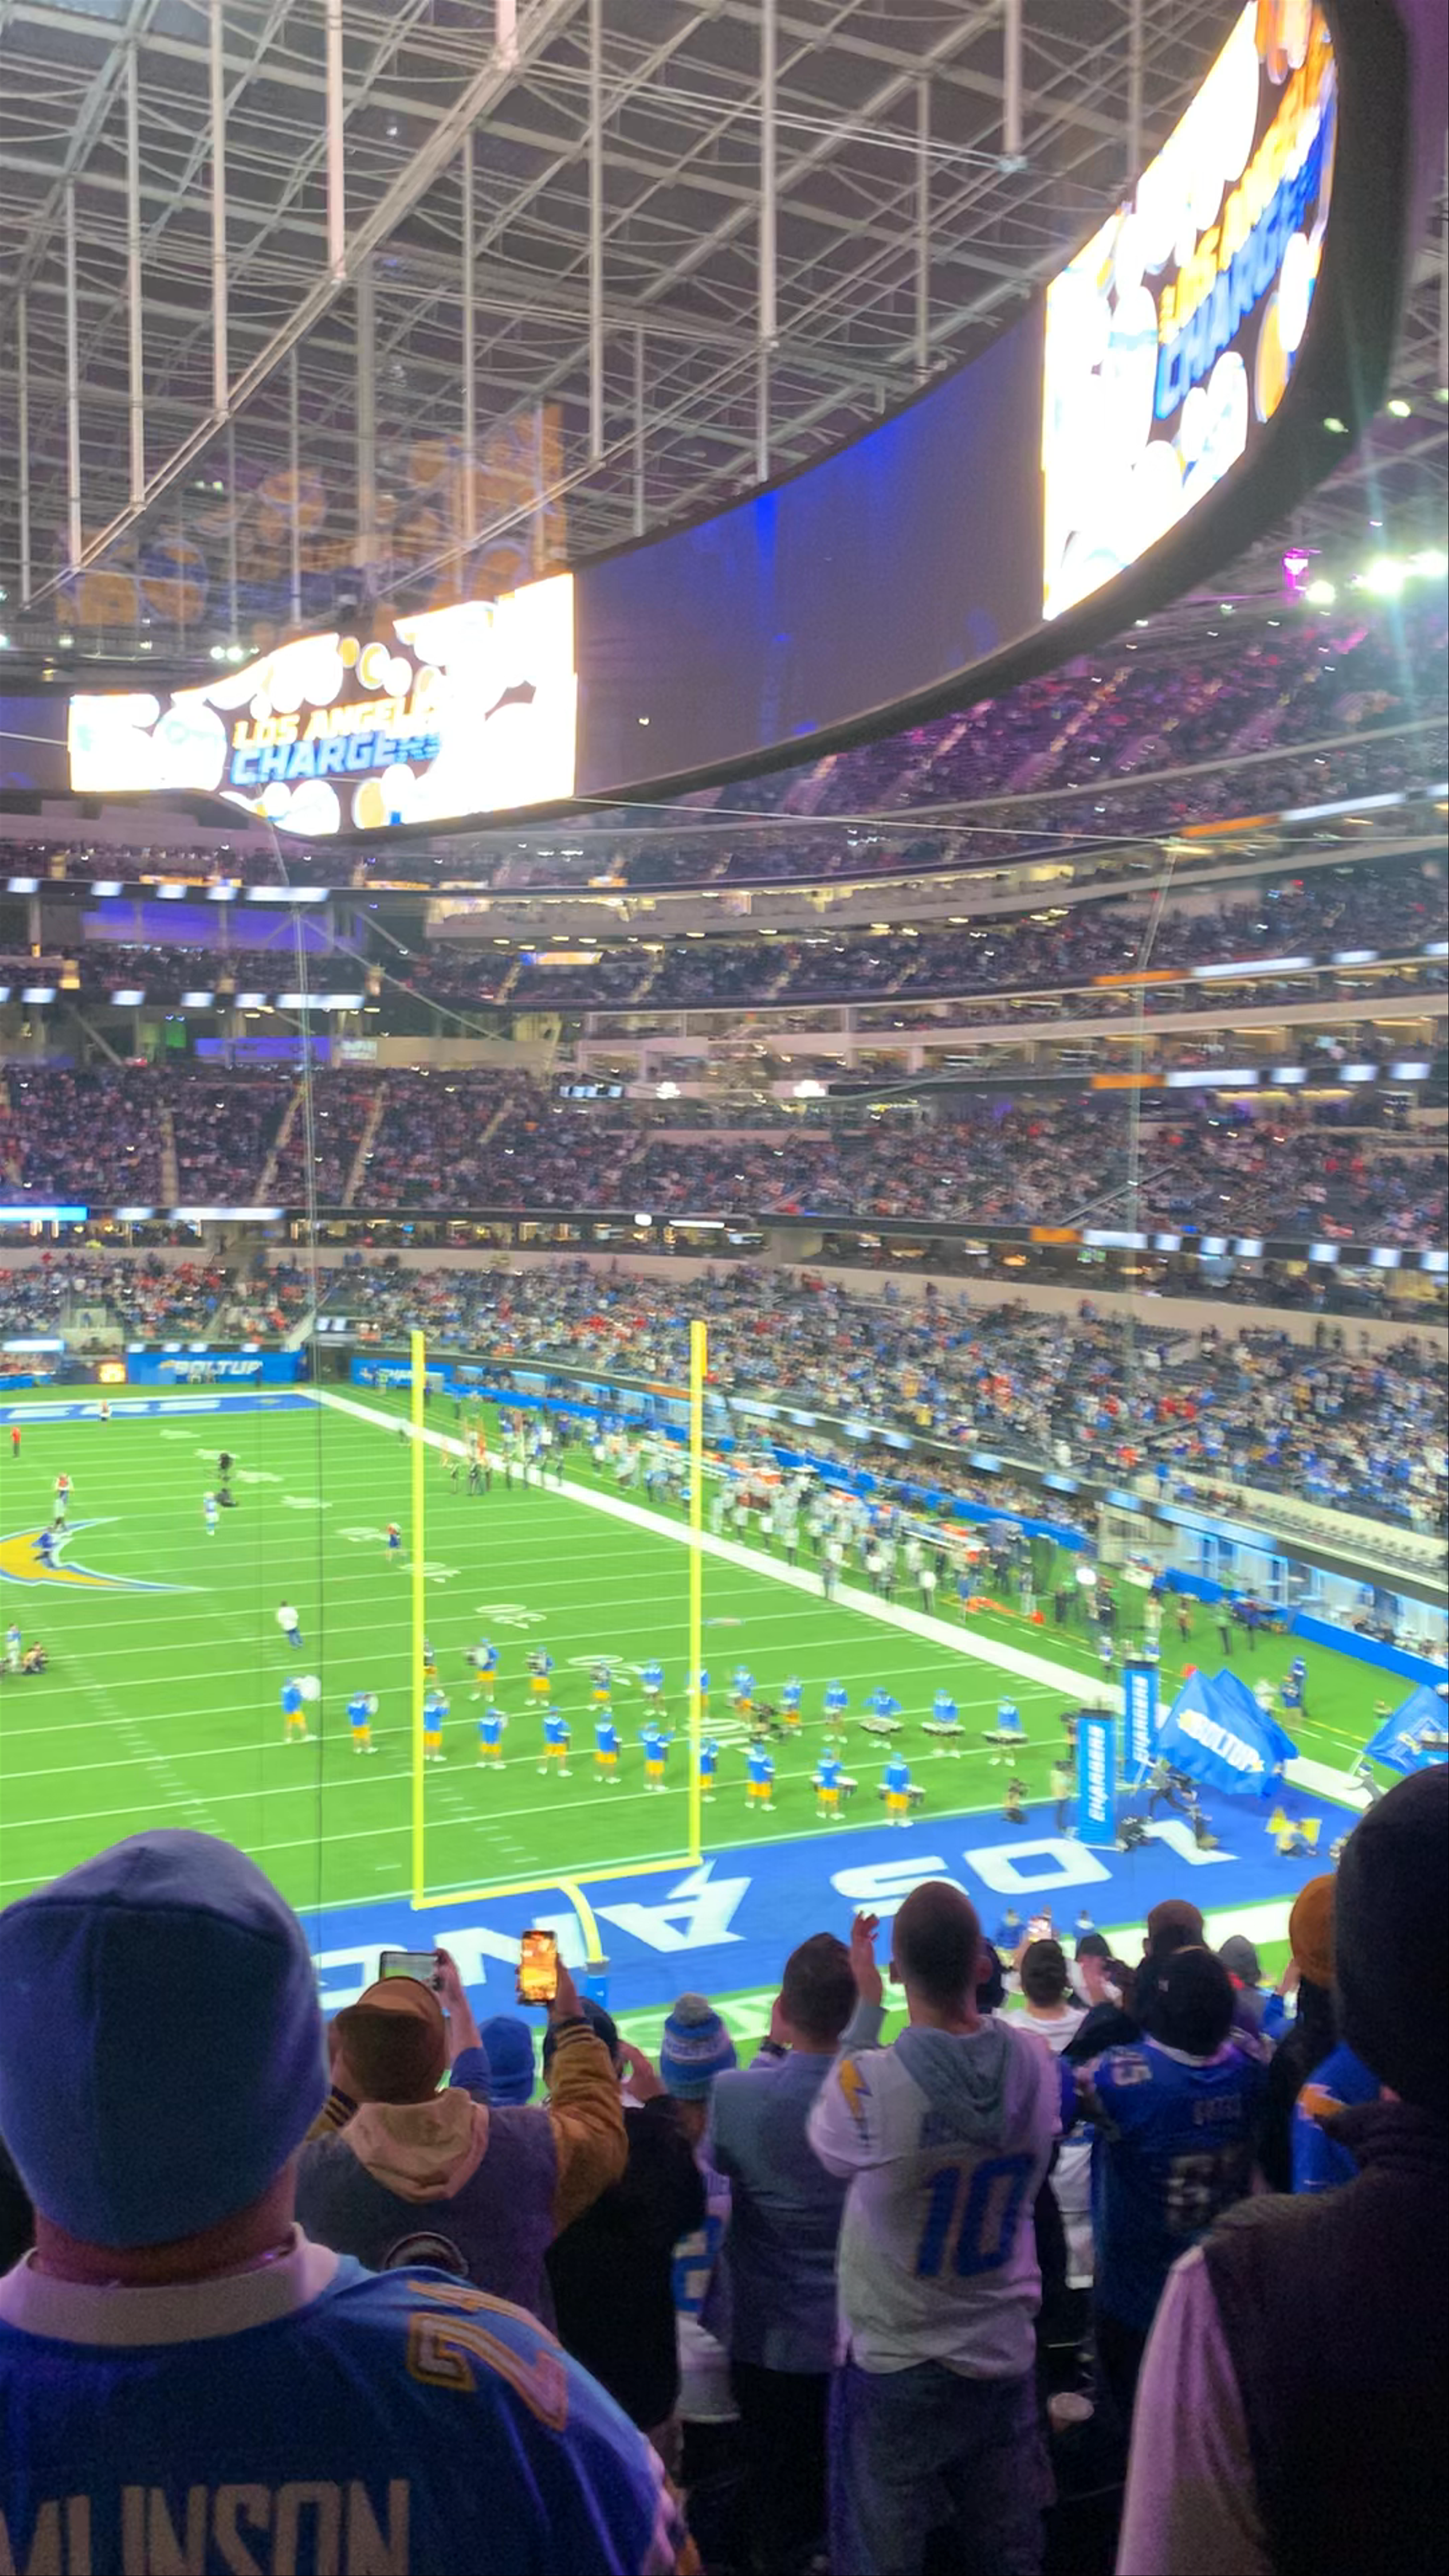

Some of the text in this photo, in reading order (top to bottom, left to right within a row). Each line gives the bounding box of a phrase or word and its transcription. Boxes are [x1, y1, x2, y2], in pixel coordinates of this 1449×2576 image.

[232, 695, 438, 751] LOS ANGEL
[916, 2153, 1038, 2277] 10
